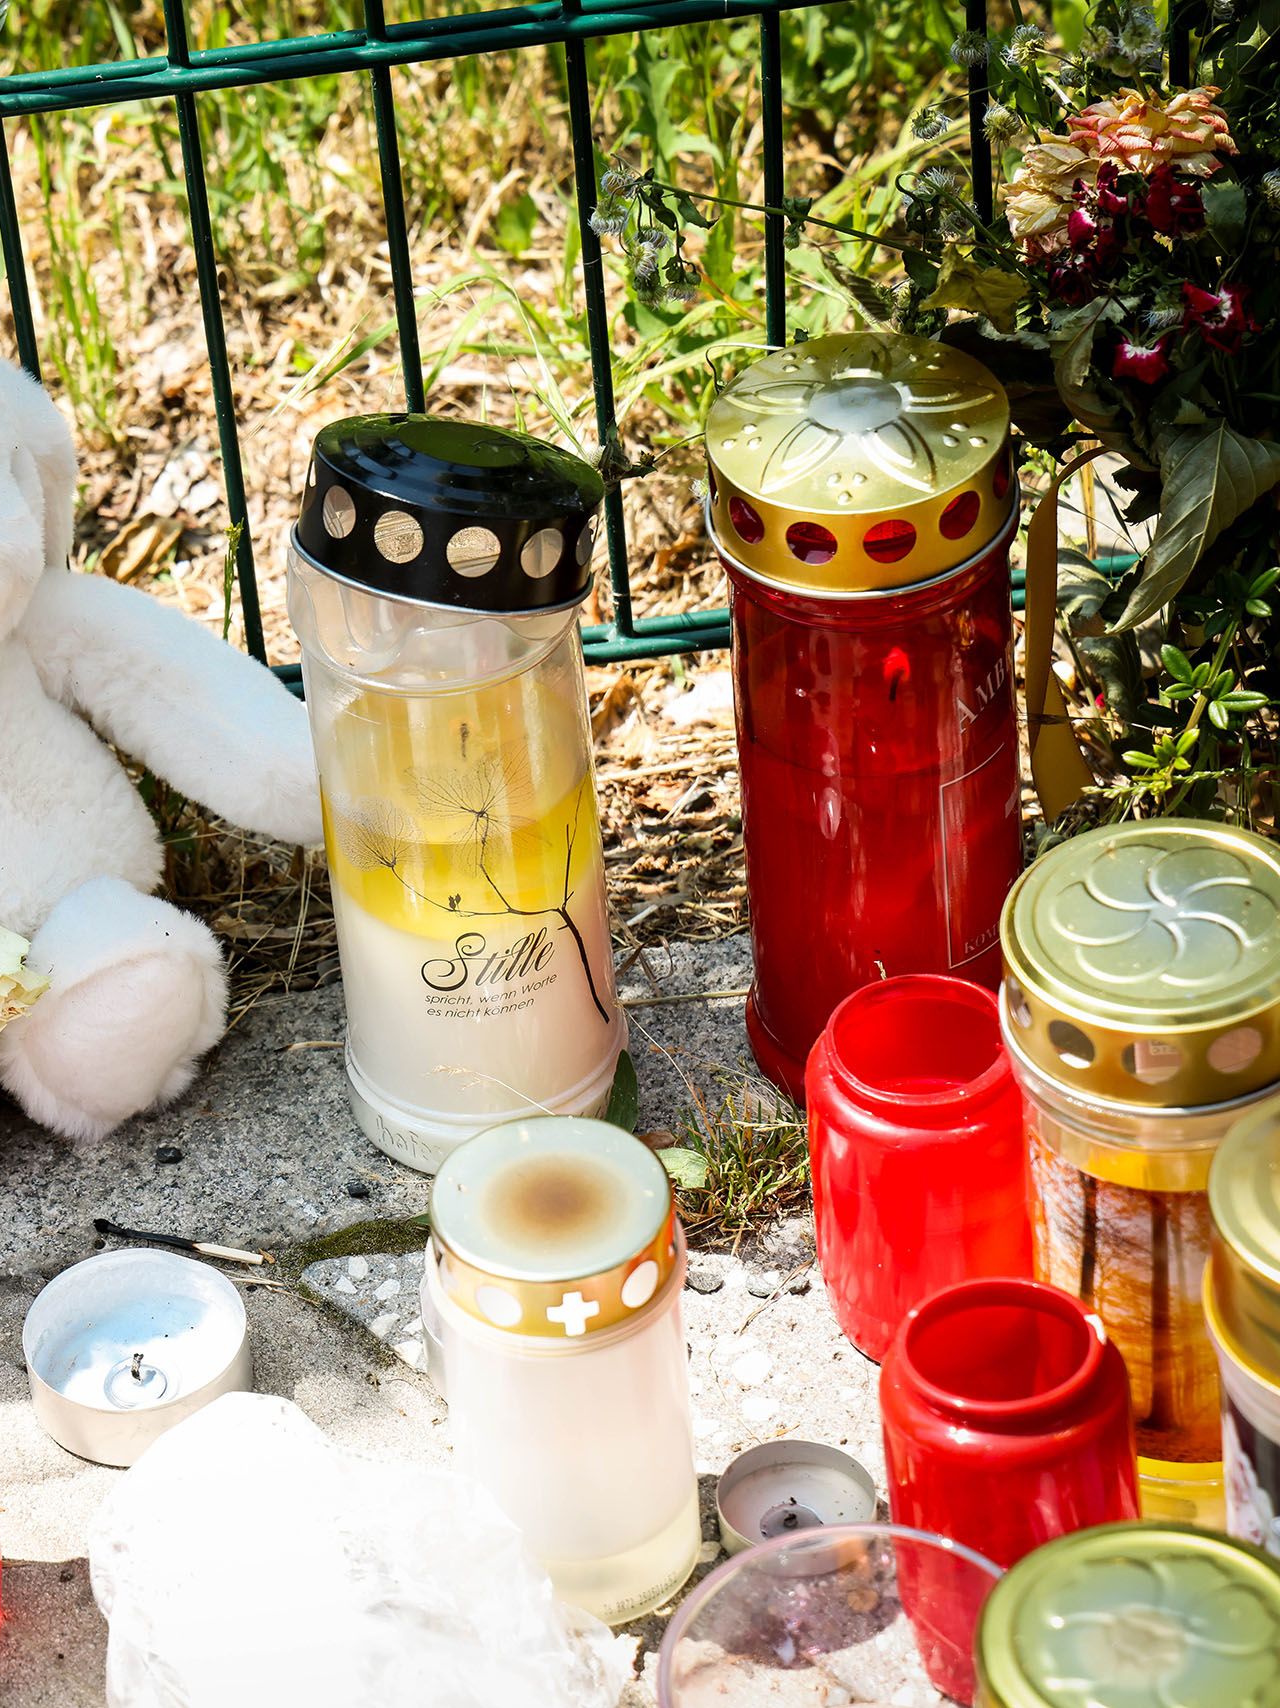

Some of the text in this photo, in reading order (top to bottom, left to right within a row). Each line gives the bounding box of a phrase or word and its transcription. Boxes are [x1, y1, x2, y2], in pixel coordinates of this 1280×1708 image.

[421, 927, 555, 992] Stille
[425, 974, 557, 1005] spricht, wenn Worte
[427, 998, 534, 1018] es nicht können
